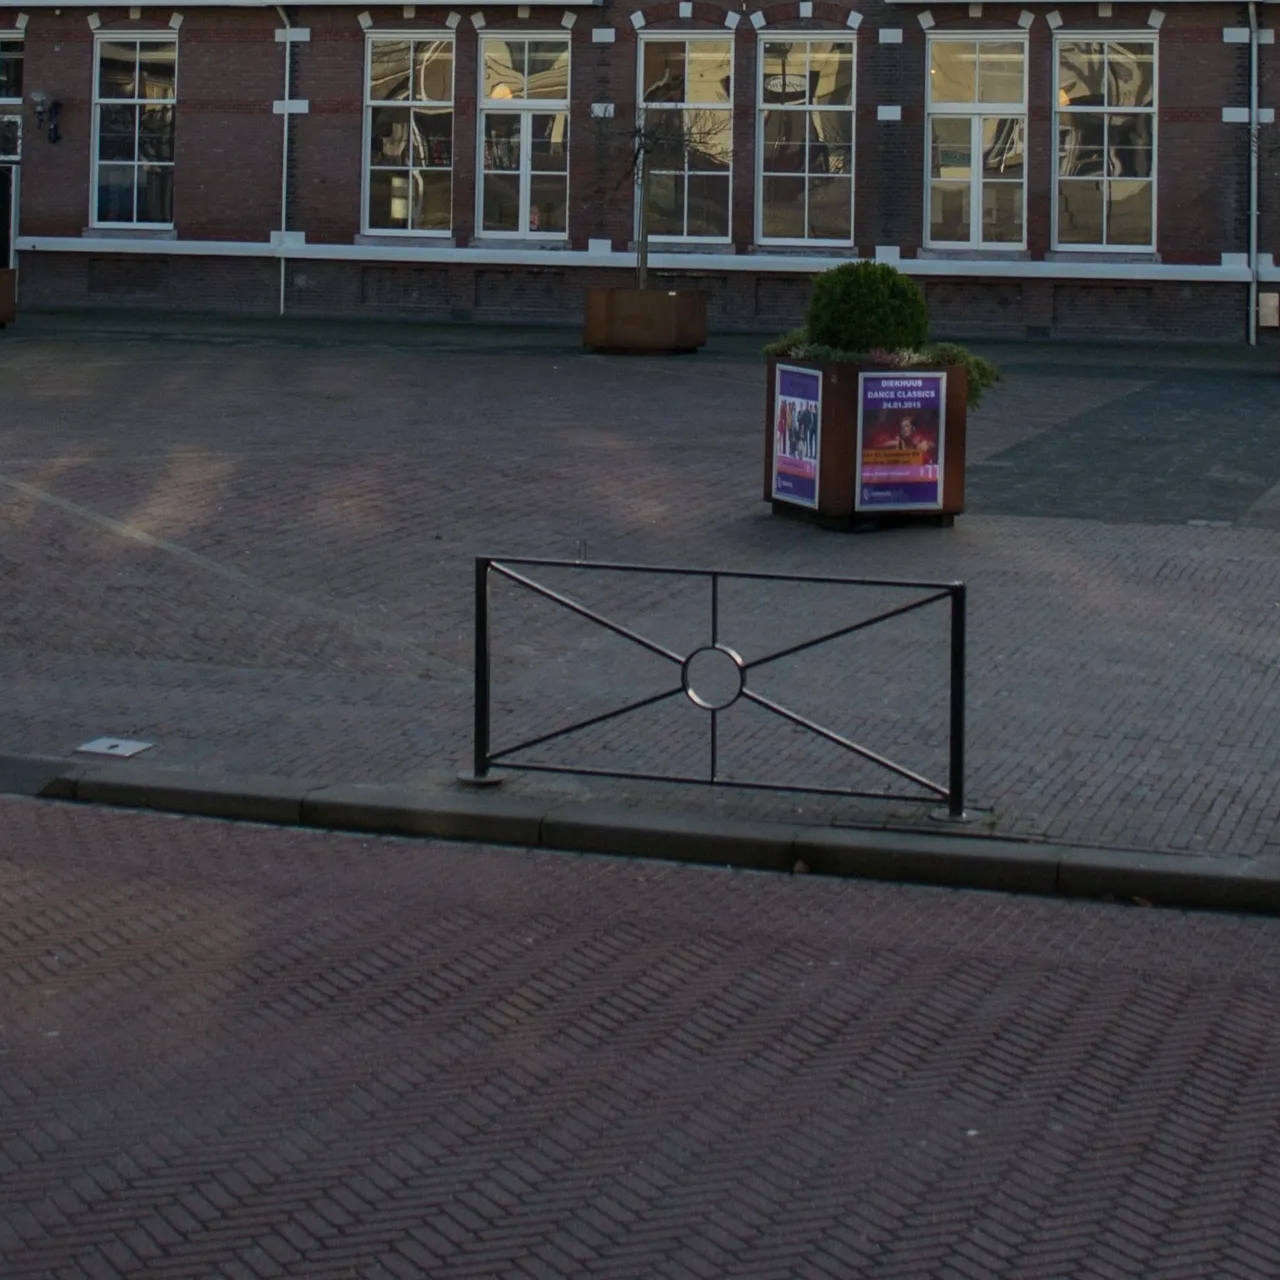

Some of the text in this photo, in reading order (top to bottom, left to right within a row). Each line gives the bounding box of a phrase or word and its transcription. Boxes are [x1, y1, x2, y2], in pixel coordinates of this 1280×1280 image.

[881, 379, 923, 388] DIEKHUUS
[867, 390, 936, 399] DANCE CLASSICS
